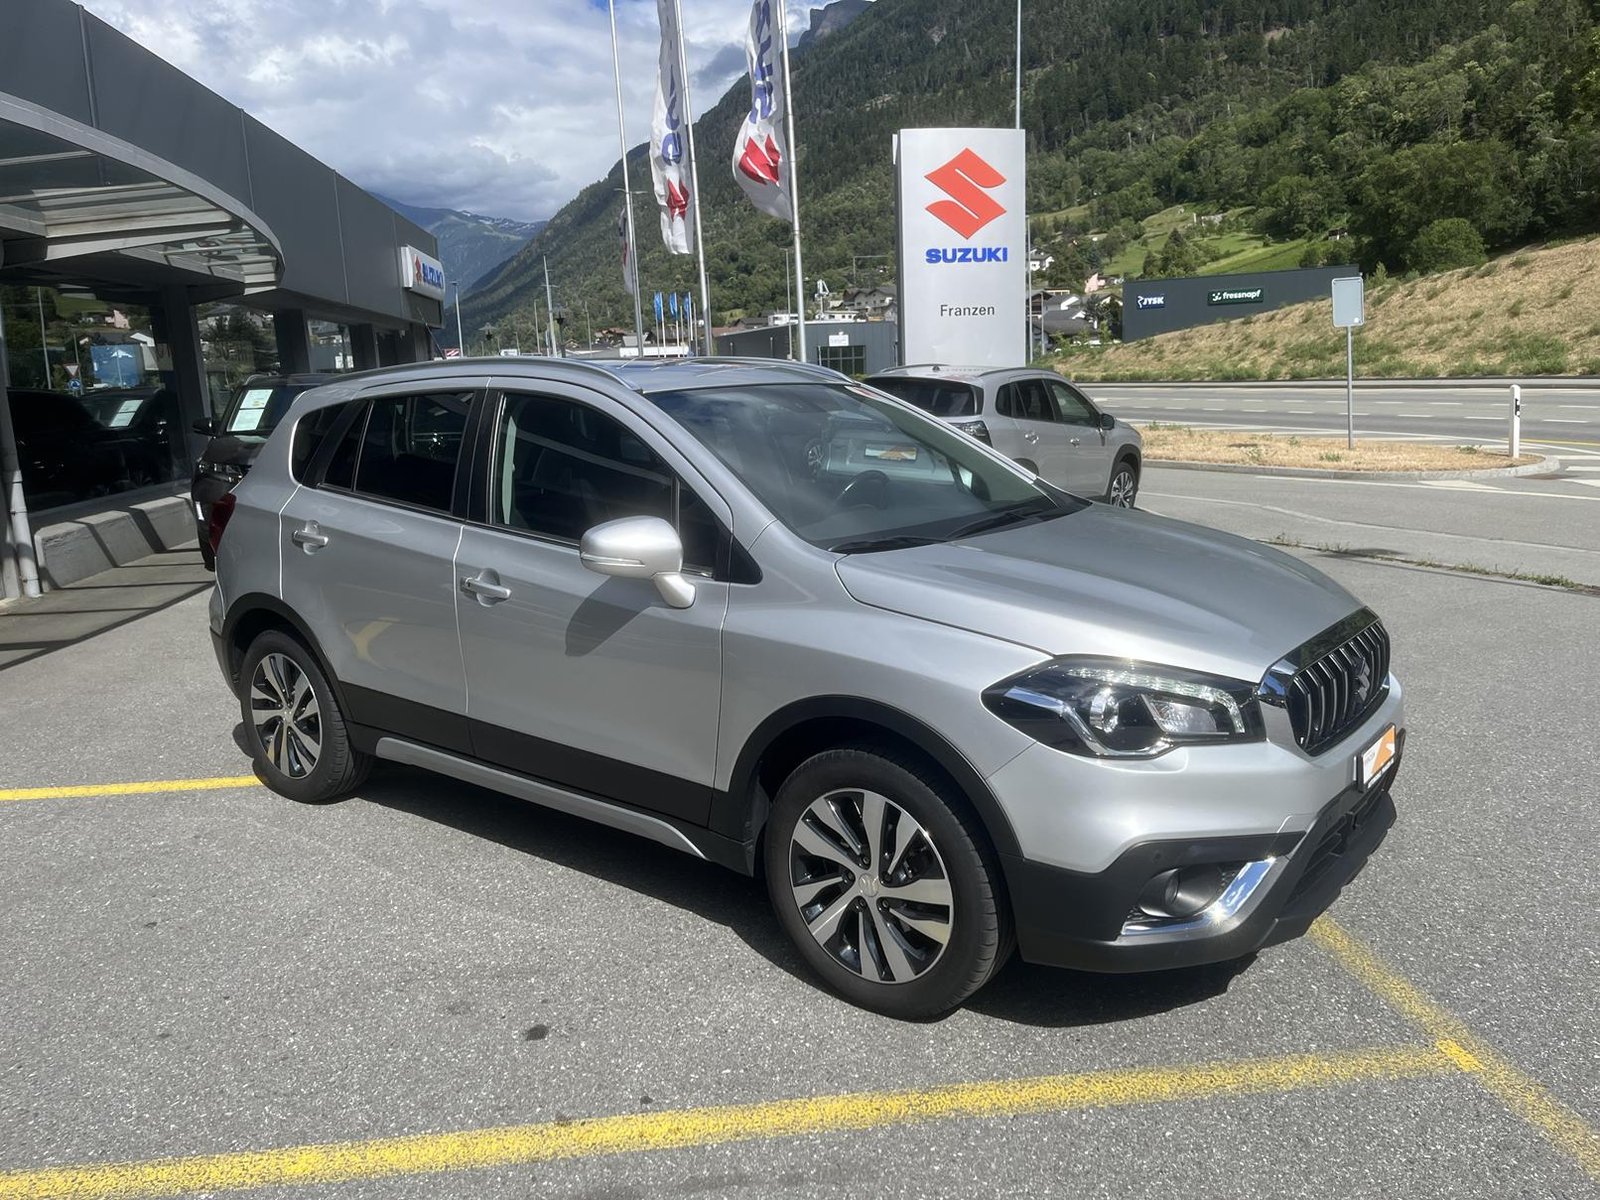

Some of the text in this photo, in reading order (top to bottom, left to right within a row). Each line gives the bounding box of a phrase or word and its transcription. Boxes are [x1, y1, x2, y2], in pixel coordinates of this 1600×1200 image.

[925, 247, 1008, 264] SUZUKI
[1143, 296, 1164, 305] JYSK
[1222, 289, 1262, 300] fressnapf
[940, 304, 995, 317] Franzen
